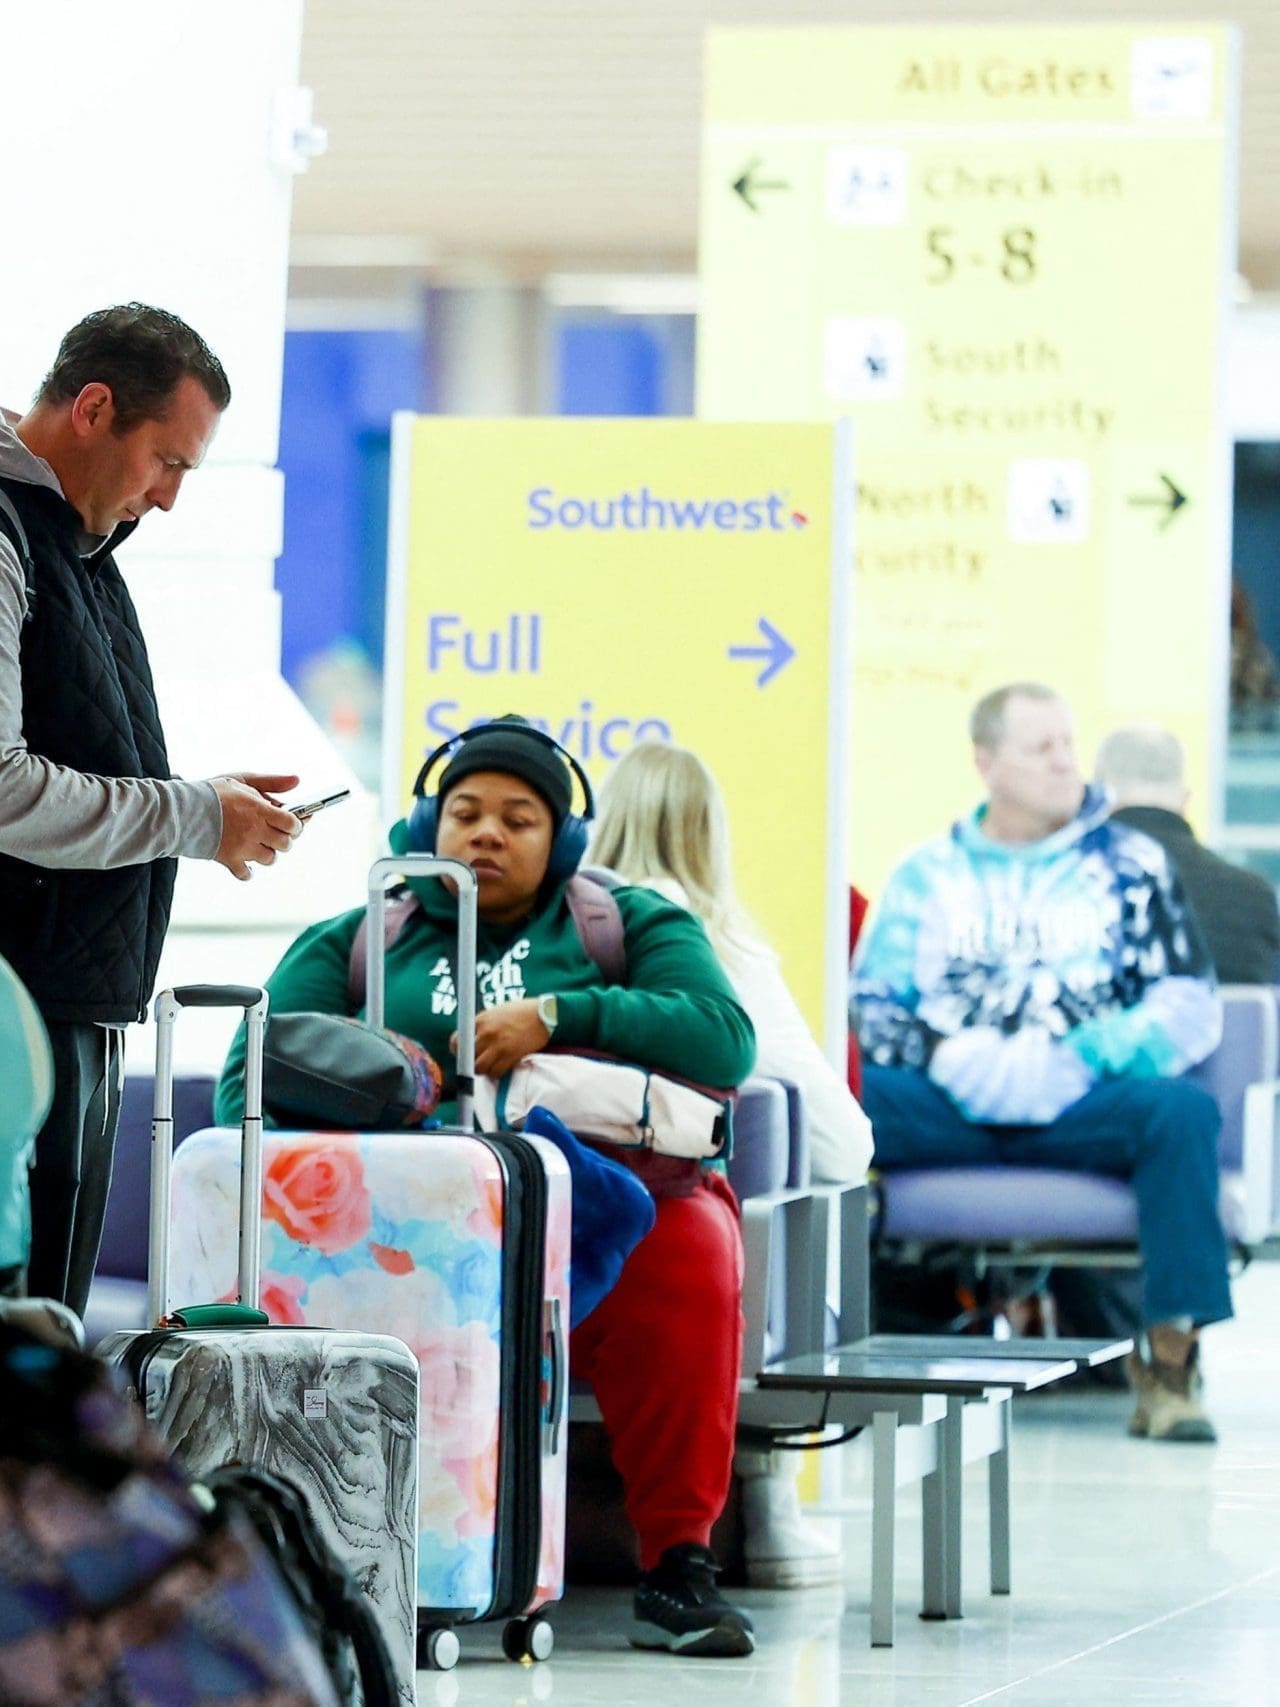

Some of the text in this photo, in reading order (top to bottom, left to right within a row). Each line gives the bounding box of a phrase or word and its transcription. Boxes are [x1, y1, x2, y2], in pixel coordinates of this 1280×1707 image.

[898, 58, 1115, 96] All Gates
[926, 225, 955, 287] 5
[1001, 225, 1037, 287] 8
[926, 338, 1061, 376] South
[528, 487, 785, 531] Southwest
[428, 613, 541, 674] Full
